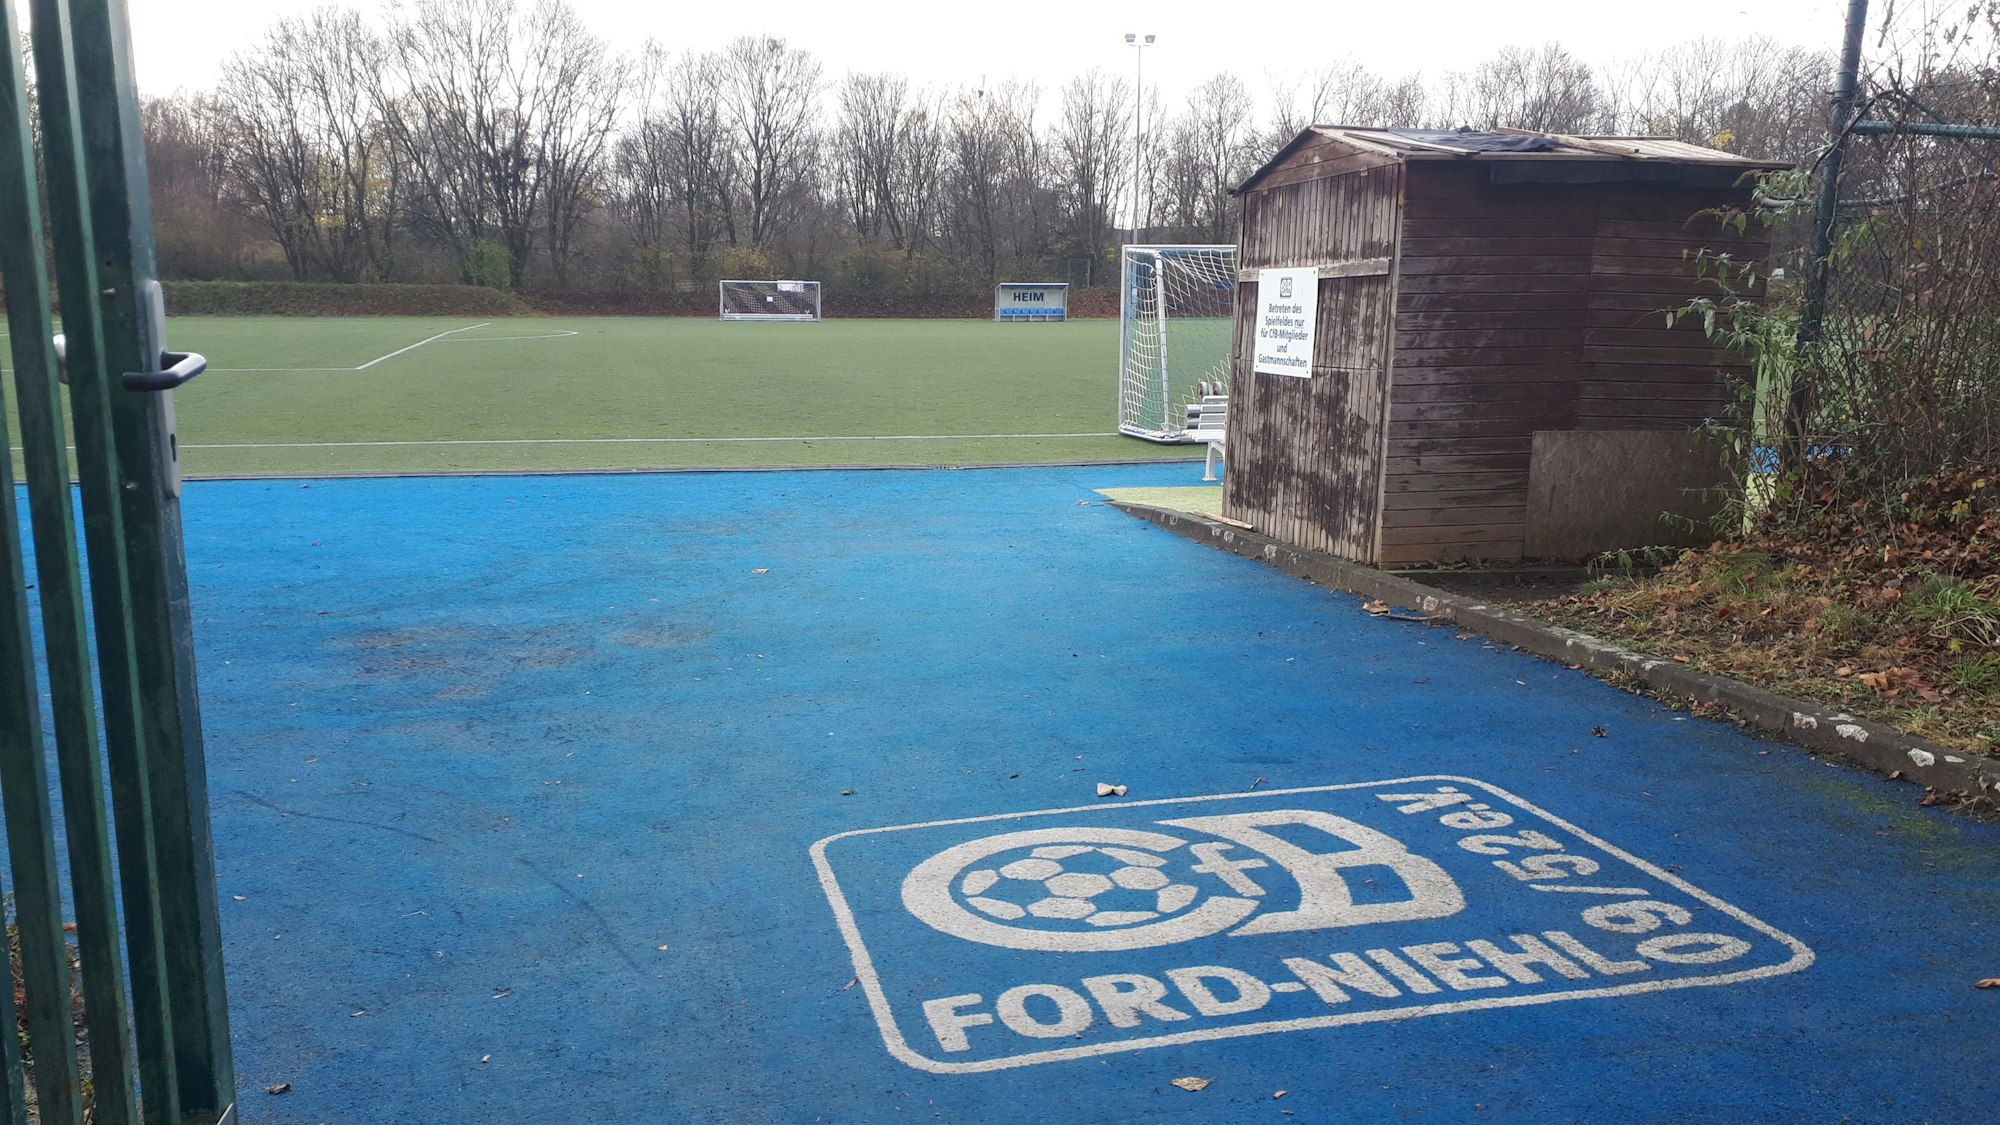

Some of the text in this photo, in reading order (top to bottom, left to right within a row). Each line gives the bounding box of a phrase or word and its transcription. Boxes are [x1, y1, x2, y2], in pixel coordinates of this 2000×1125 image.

[1013, 292, 1044, 302] HEIM
[1268, 303, 1302, 314] Betreten des
[1265, 315, 1305, 328] Spielfeldes nur
[1260, 328, 1308, 342] für CfB-Mitglieder
[1276, 343, 1288, 353] und
[1258, 353, 1307, 368] Gastmannschaften
[901, 809, 1465, 951] CfB
[922, 930, 1652, 1052] FORD-NIEHL
